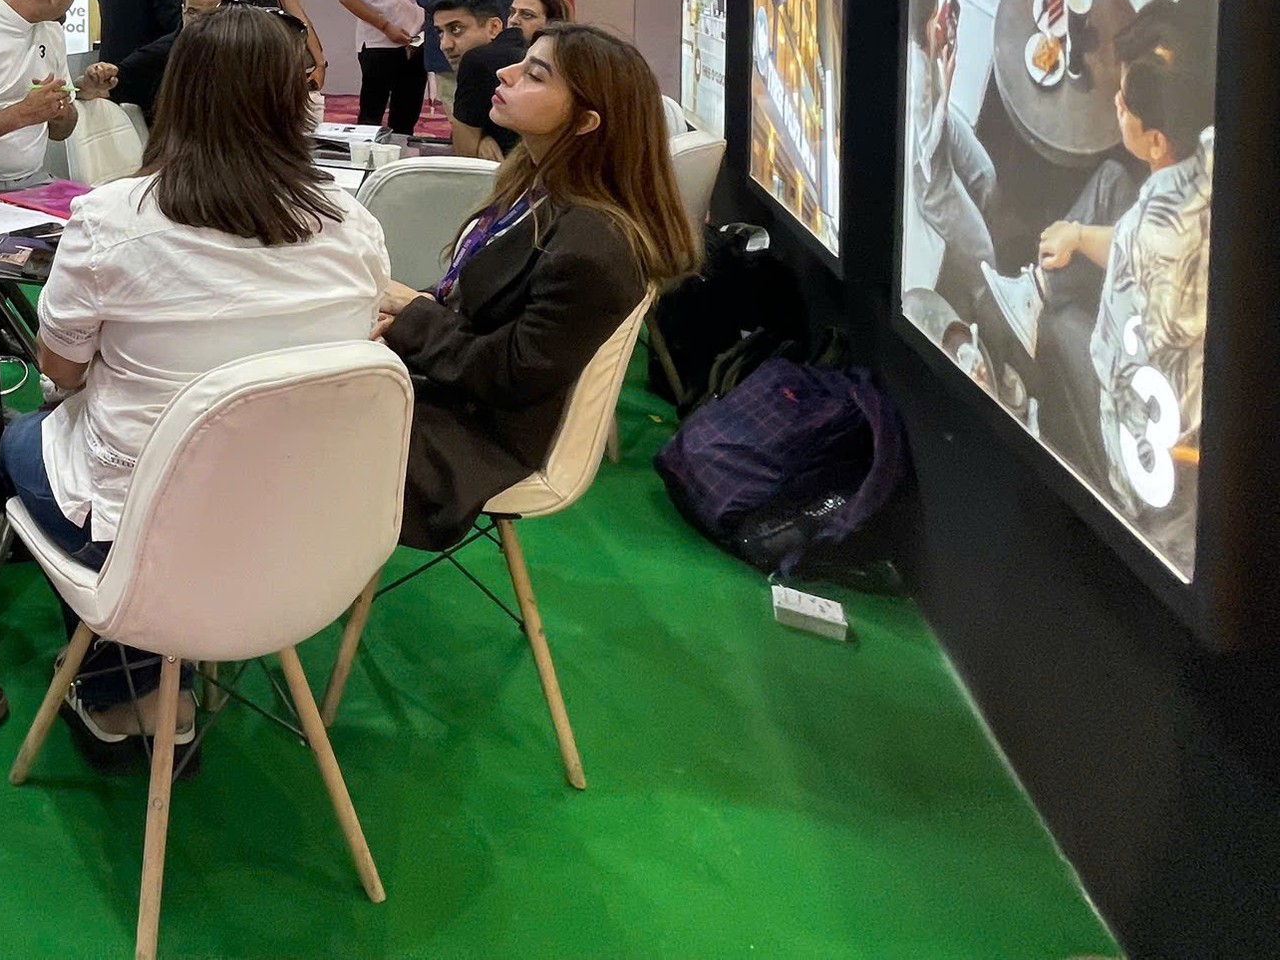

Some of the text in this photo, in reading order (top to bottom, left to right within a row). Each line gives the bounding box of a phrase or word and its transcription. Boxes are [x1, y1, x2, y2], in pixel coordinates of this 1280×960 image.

[67, 7, 86, 17] ve
[62, 19, 86, 33] od
[38, 44, 47, 59] 3
[1119, 365, 1181, 508] 3
